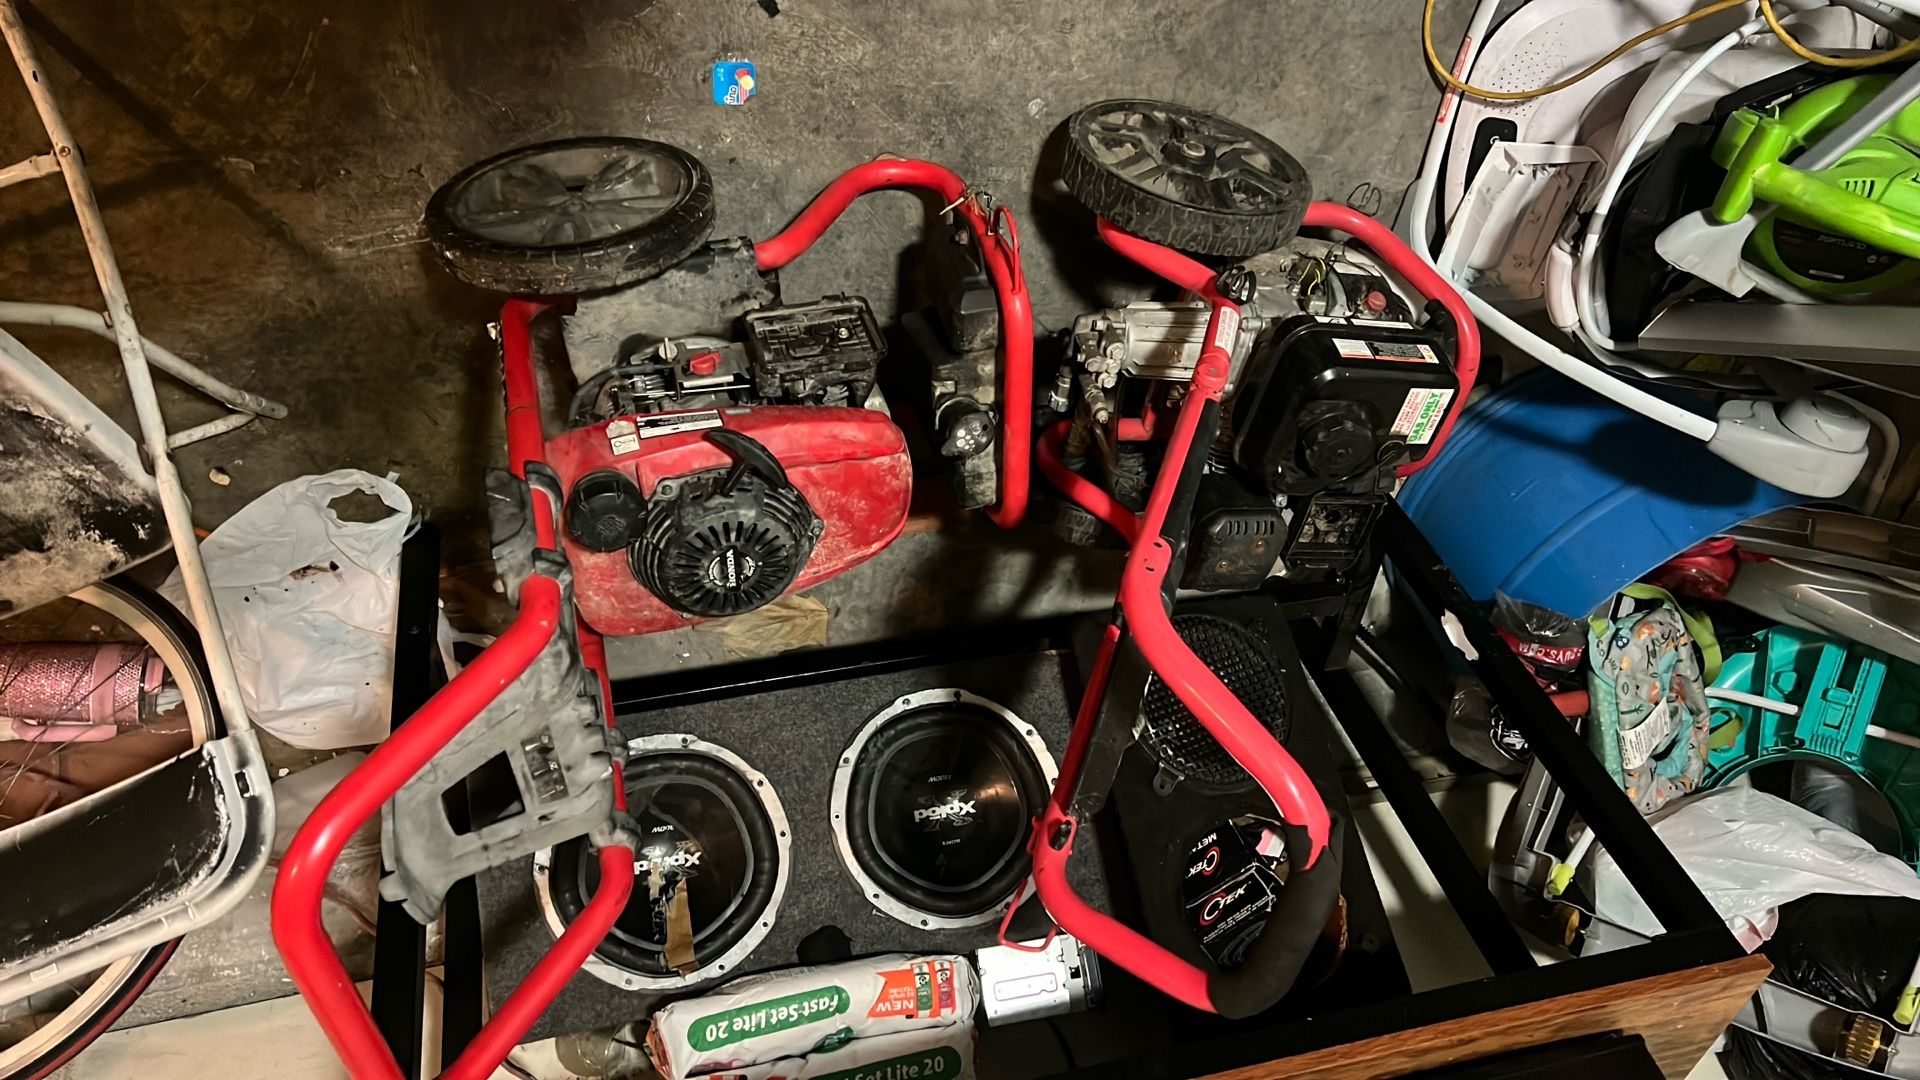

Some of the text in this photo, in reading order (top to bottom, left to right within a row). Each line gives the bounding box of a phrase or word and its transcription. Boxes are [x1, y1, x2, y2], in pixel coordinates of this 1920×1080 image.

[1408, 392, 1439, 442] GAS ONLY
[726, 549, 737, 588] HONDA
[634, 852, 701, 875] Xpd
[878, 999, 914, 1012] NEW
[732, 1008, 767, 1033] Lite
[705, 1023, 729, 1043] 20
[887, 1064, 918, 1080] Lite
[923, 1056, 944, 1075] 20
